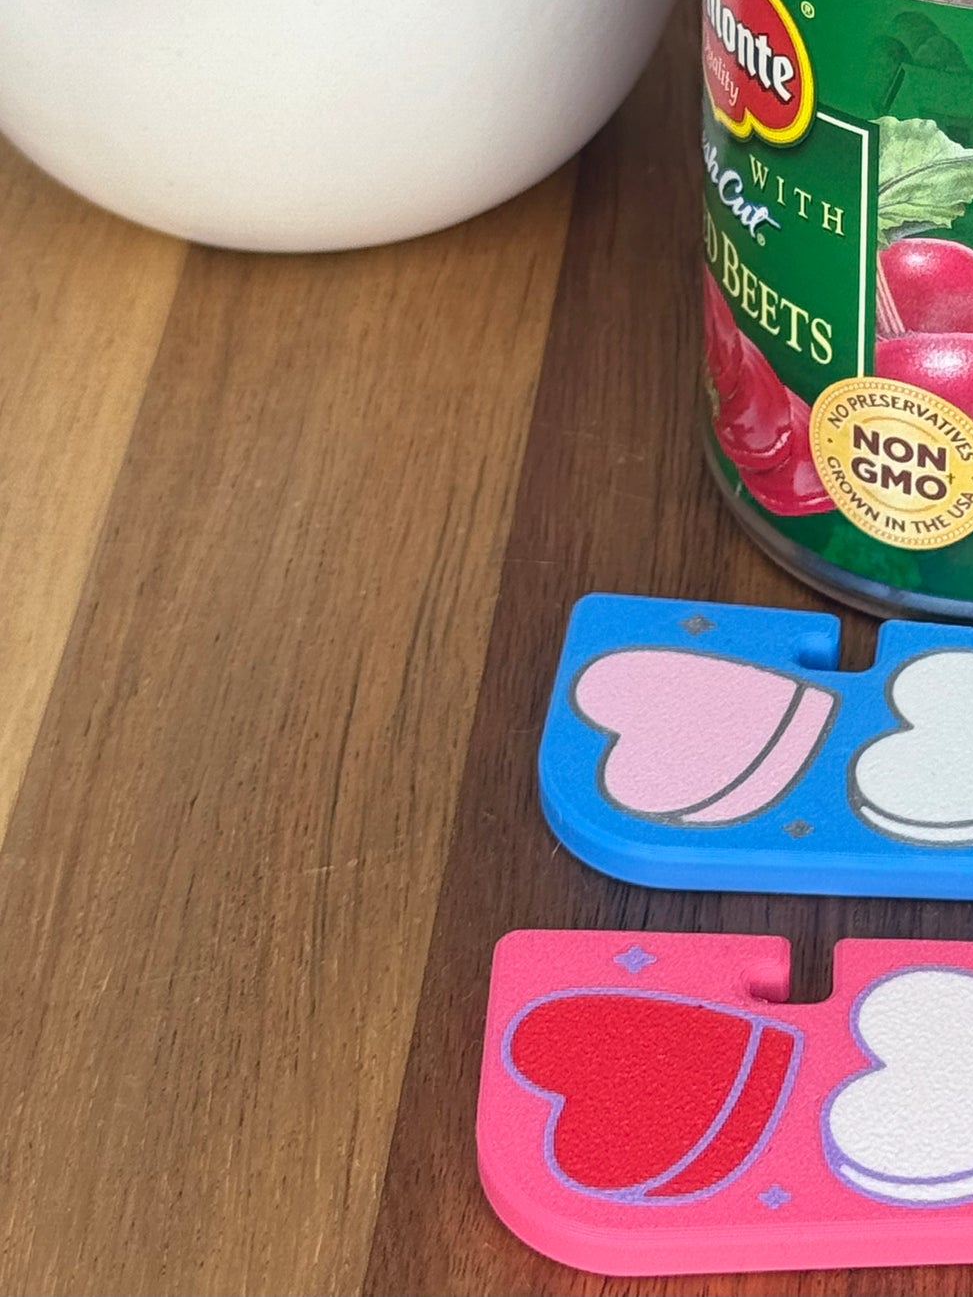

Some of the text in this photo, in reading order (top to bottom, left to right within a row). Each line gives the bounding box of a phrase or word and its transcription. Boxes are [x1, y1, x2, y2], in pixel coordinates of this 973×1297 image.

[749, 154, 845, 235] WITH
[721, 231, 833, 365] BEETS
[827, 403, 850, 430] NO
[852, 424, 947, 473] NON
[826, 456, 881, 523] GROWN
[885, 515, 906, 533] IN
[911, 514, 951, 536] THE
